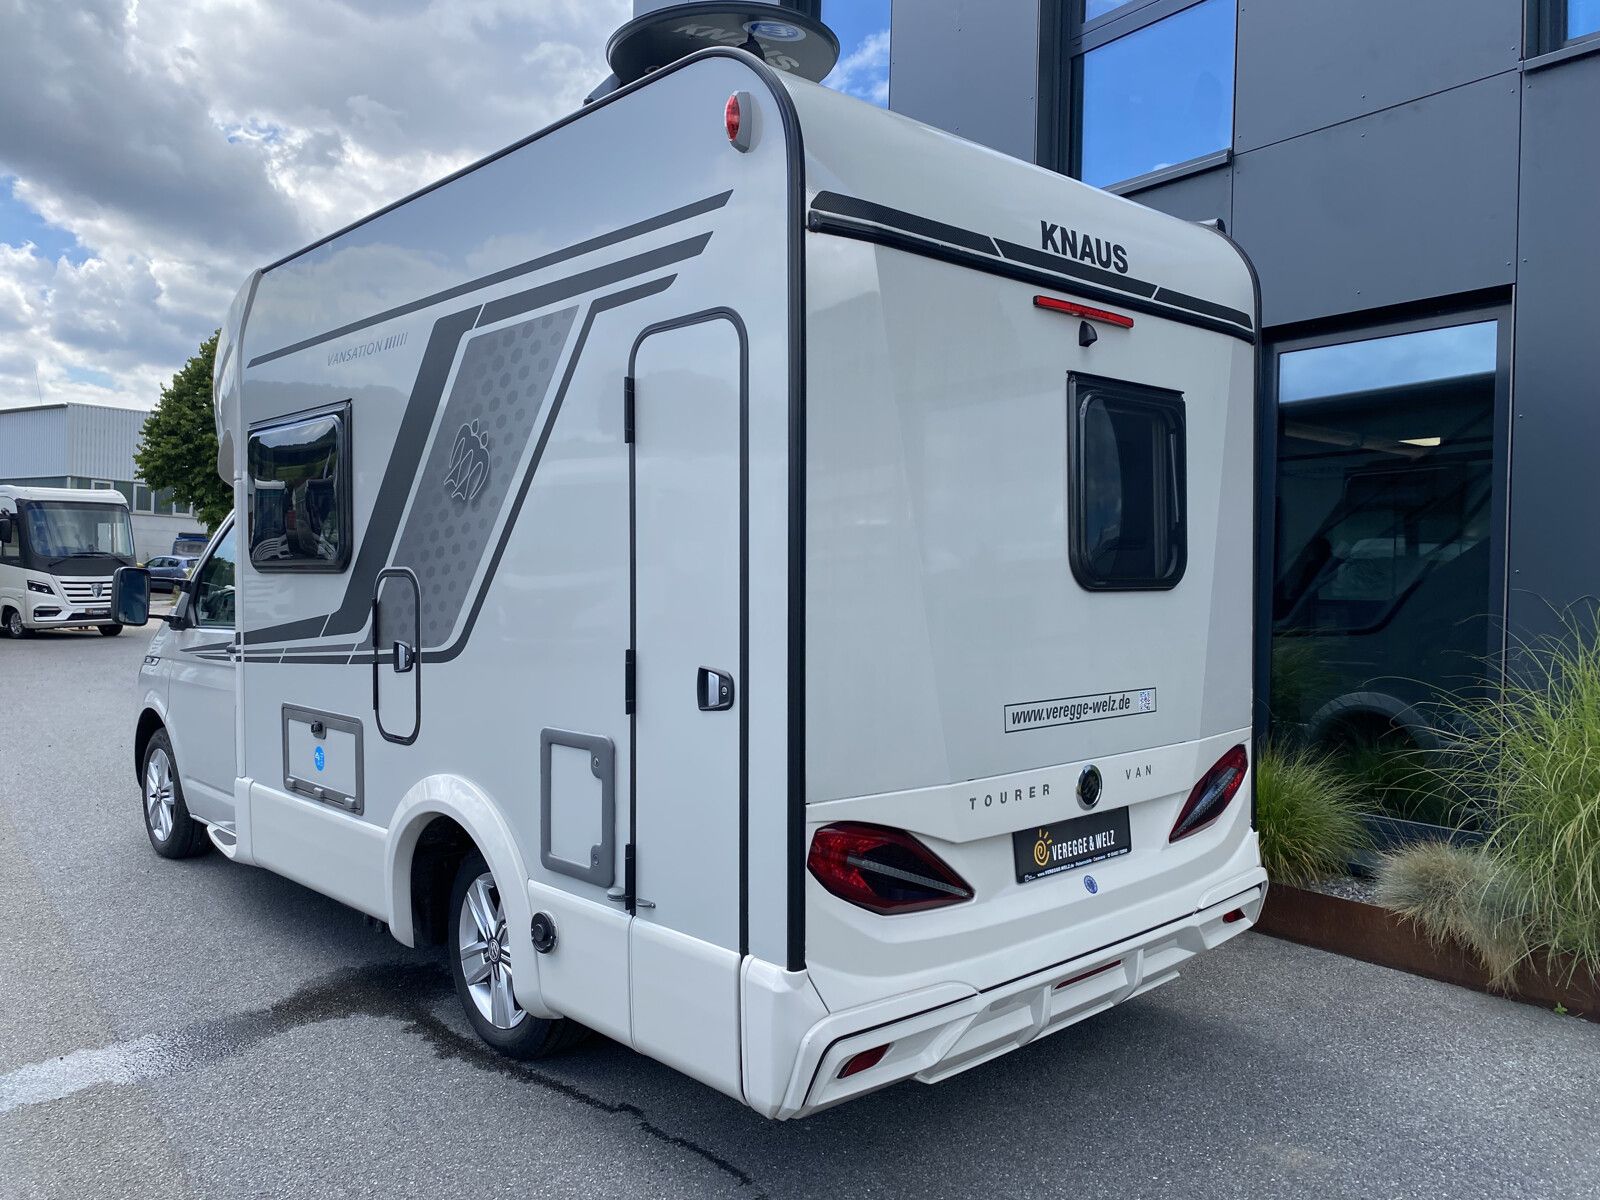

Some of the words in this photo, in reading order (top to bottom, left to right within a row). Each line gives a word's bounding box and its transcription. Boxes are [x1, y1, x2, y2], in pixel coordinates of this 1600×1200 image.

[1040, 220, 1129, 274] KNAUS
[327, 337, 382, 367] VANSATION
[1011, 694, 1131, 725] www.veregge-welz.de
[969, 784, 1050, 810] TOURER
[1125, 764, 1152, 780] VAN
[1051, 837, 1088, 861] VEREGGE
[1088, 835, 1095, 851] &
[1095, 830, 1115, 849] WELZ
